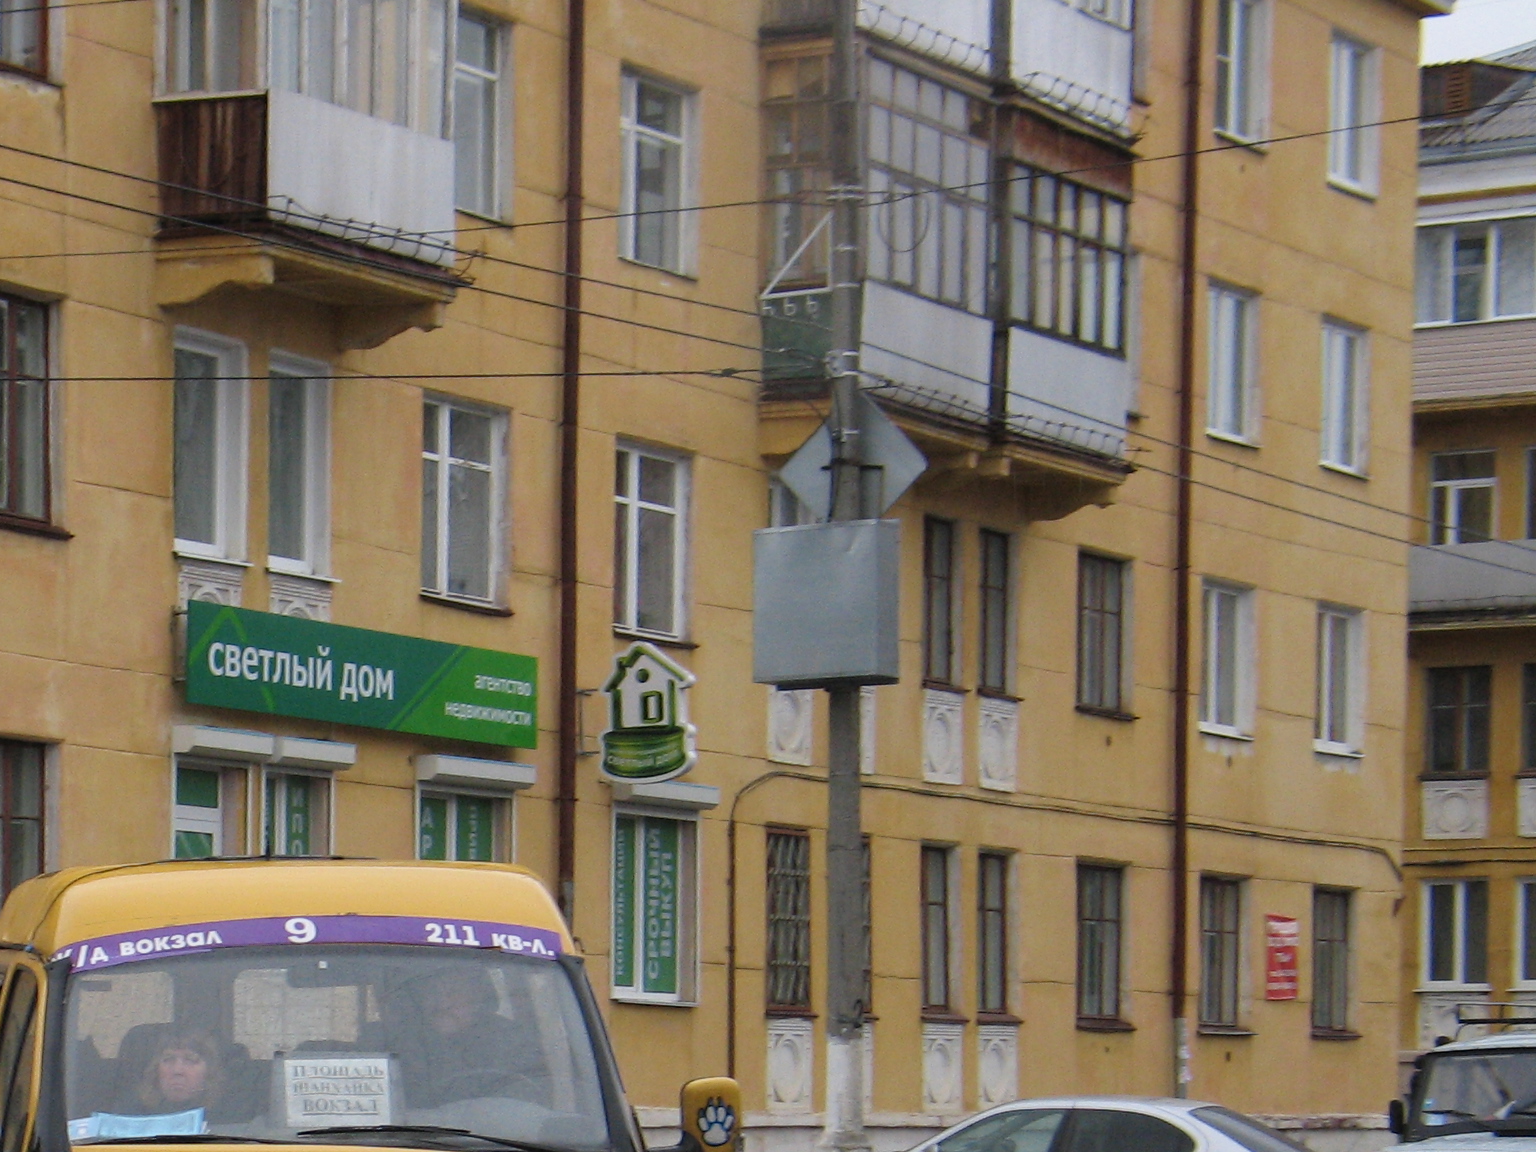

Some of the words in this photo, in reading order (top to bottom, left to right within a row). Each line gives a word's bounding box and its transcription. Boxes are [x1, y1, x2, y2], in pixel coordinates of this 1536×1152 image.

[474, 674, 532, 697] агентство
[445, 701, 532, 726] недвижимости
[647, 827, 661, 980] СРОЧНЫЙ
[661, 852, 673, 958] ВЫКУП
[284, 917, 316, 943] 9
[425, 923, 480, 946] 211
[303, 1099, 378, 1112] ВОКЗАЛ
